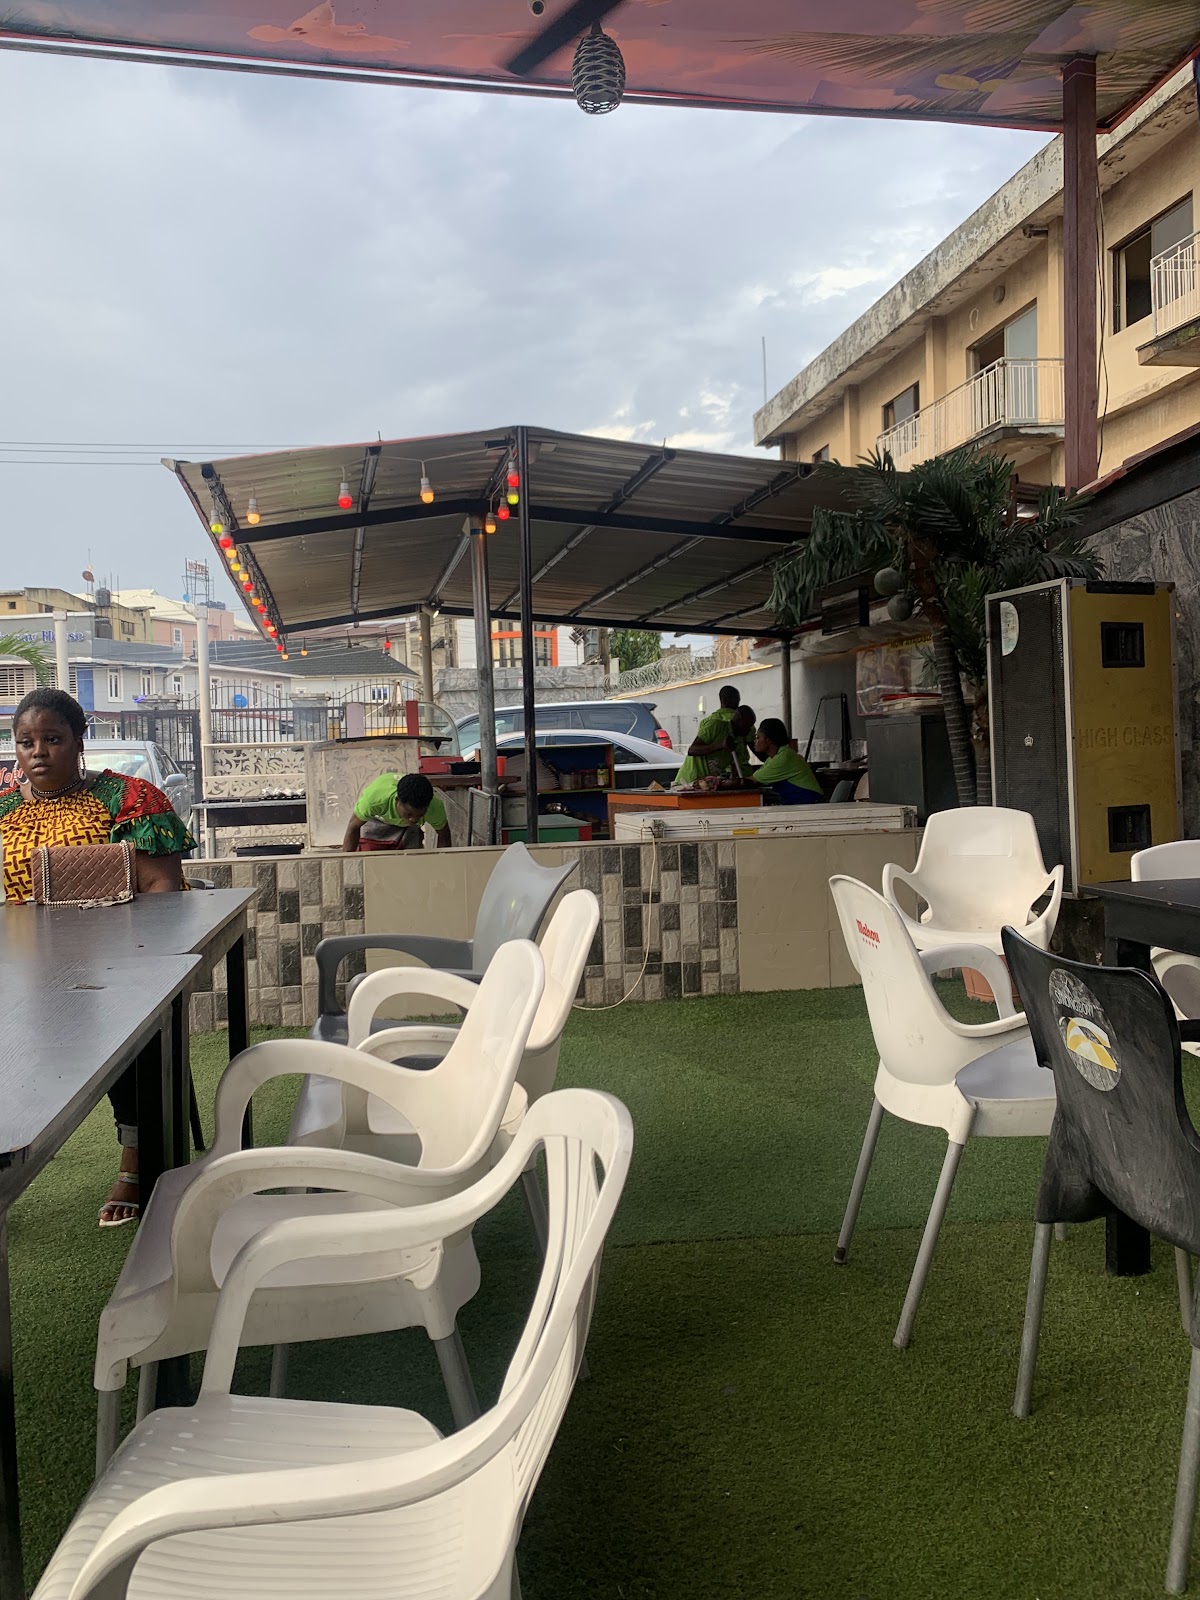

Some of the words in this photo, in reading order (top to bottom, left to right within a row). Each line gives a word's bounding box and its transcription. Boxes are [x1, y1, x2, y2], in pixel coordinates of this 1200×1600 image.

[42, 630, 84, 642] Hse
[1079, 727, 1118, 748] HIGH
[1123, 725, 1172, 746] CLASS
